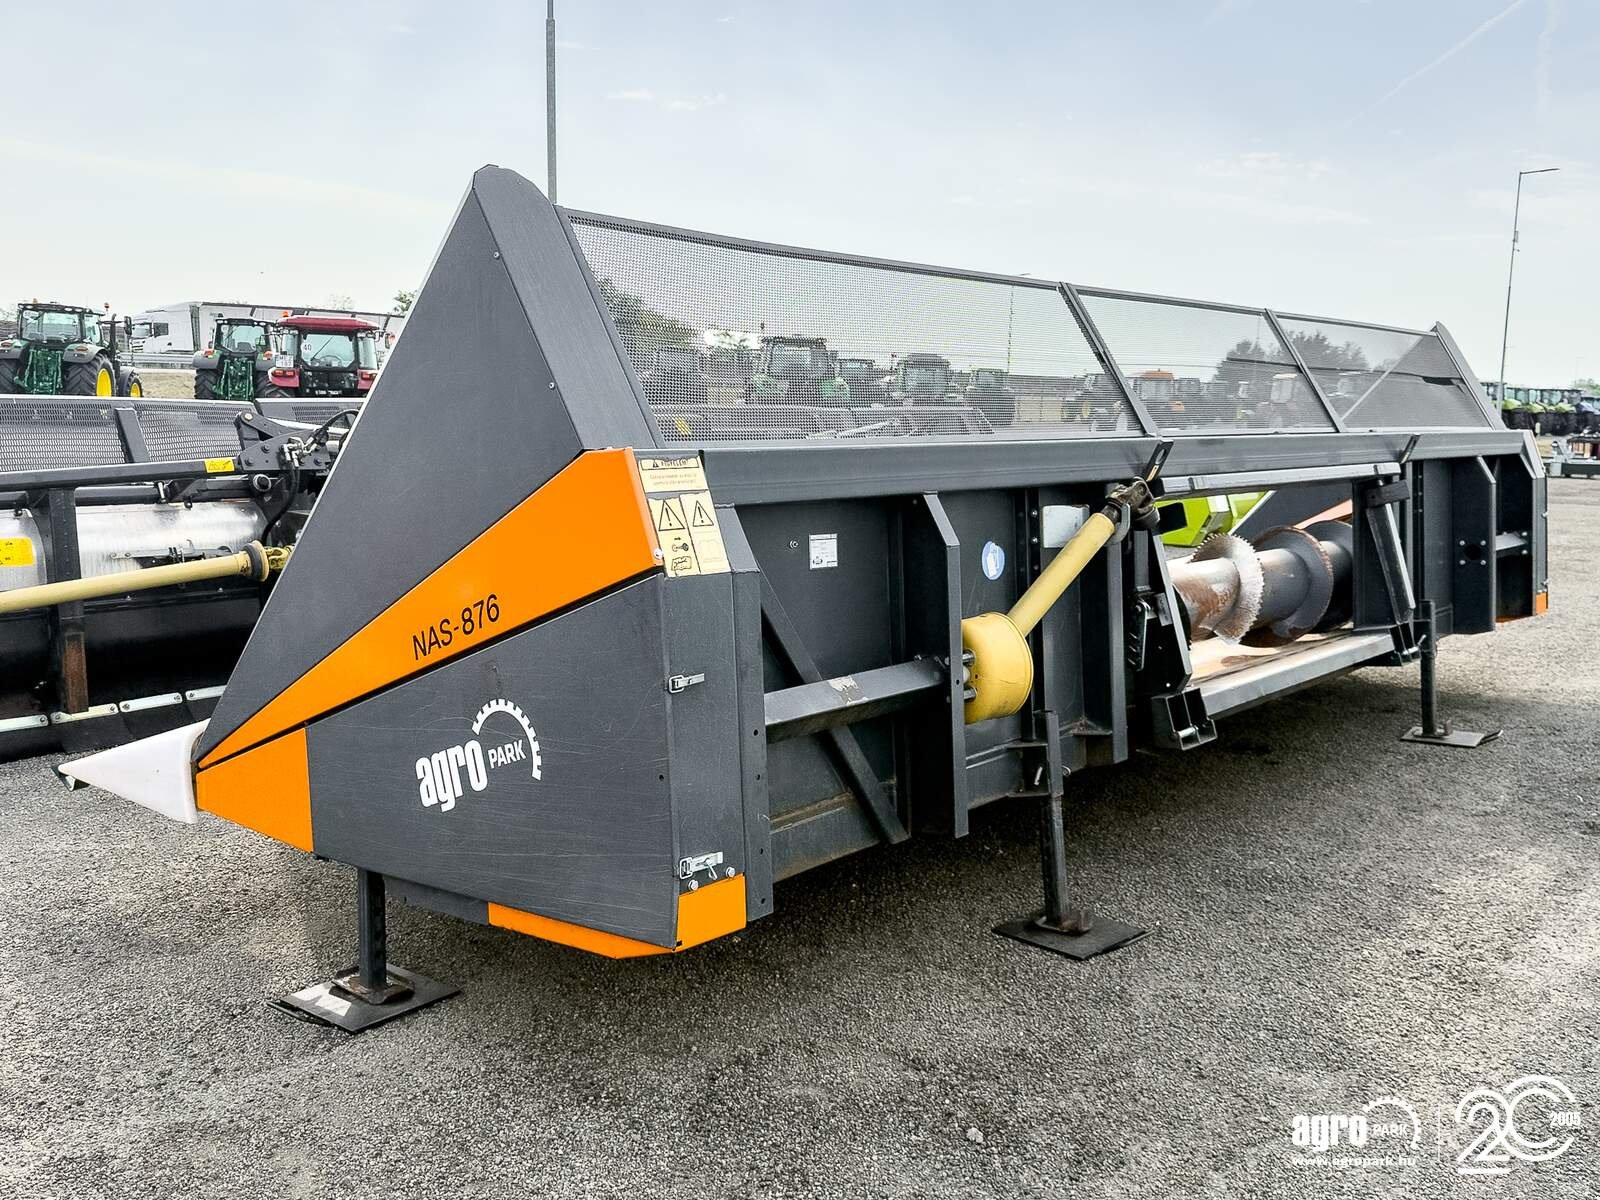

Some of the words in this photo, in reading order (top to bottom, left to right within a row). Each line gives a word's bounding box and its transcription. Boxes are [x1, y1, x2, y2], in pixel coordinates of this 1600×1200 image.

[412, 593, 500, 660] NAS-876
[415, 739, 488, 812] agro
[487, 739, 526, 769] PARK
